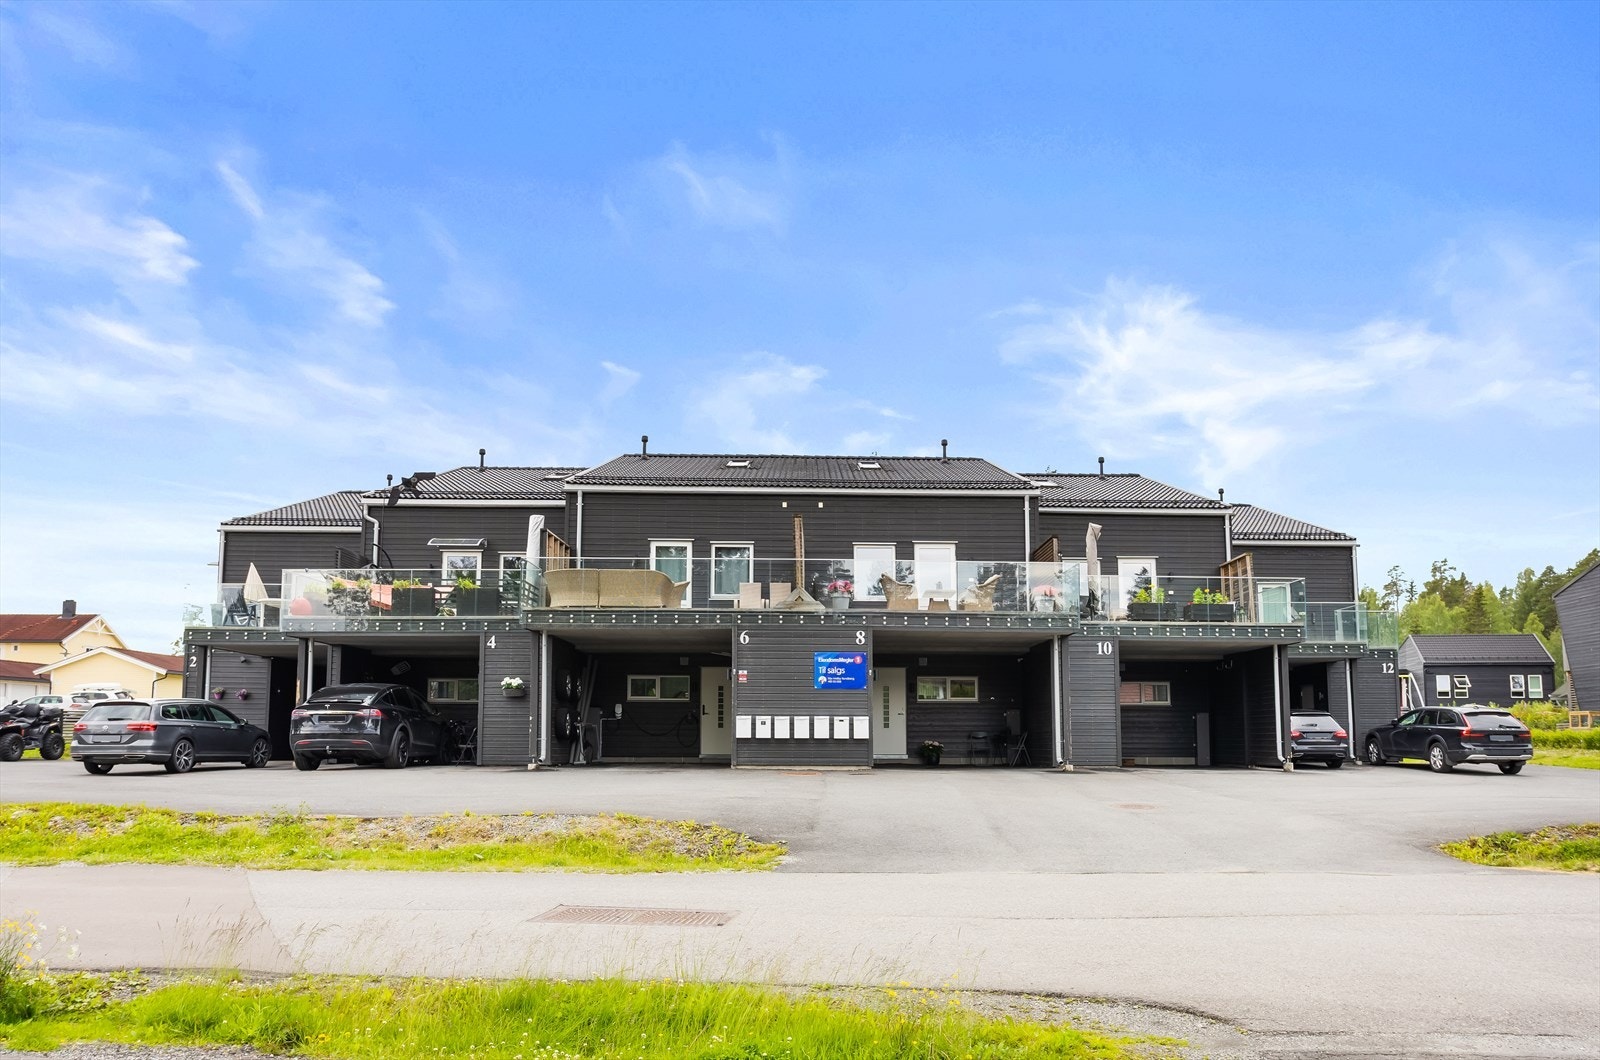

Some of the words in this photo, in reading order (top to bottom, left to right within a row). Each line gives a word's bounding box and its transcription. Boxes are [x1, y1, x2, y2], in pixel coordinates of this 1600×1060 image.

[486, 634, 497, 649] 4
[740, 630, 750, 645] 6
[856, 631, 866, 645] 8
[1095, 640, 1113, 656] 10
[189, 655, 197, 668] 2
[1381, 662, 1395, 674] 12
[819, 666, 827, 674] Til
[828, 666, 846, 675] salgs
